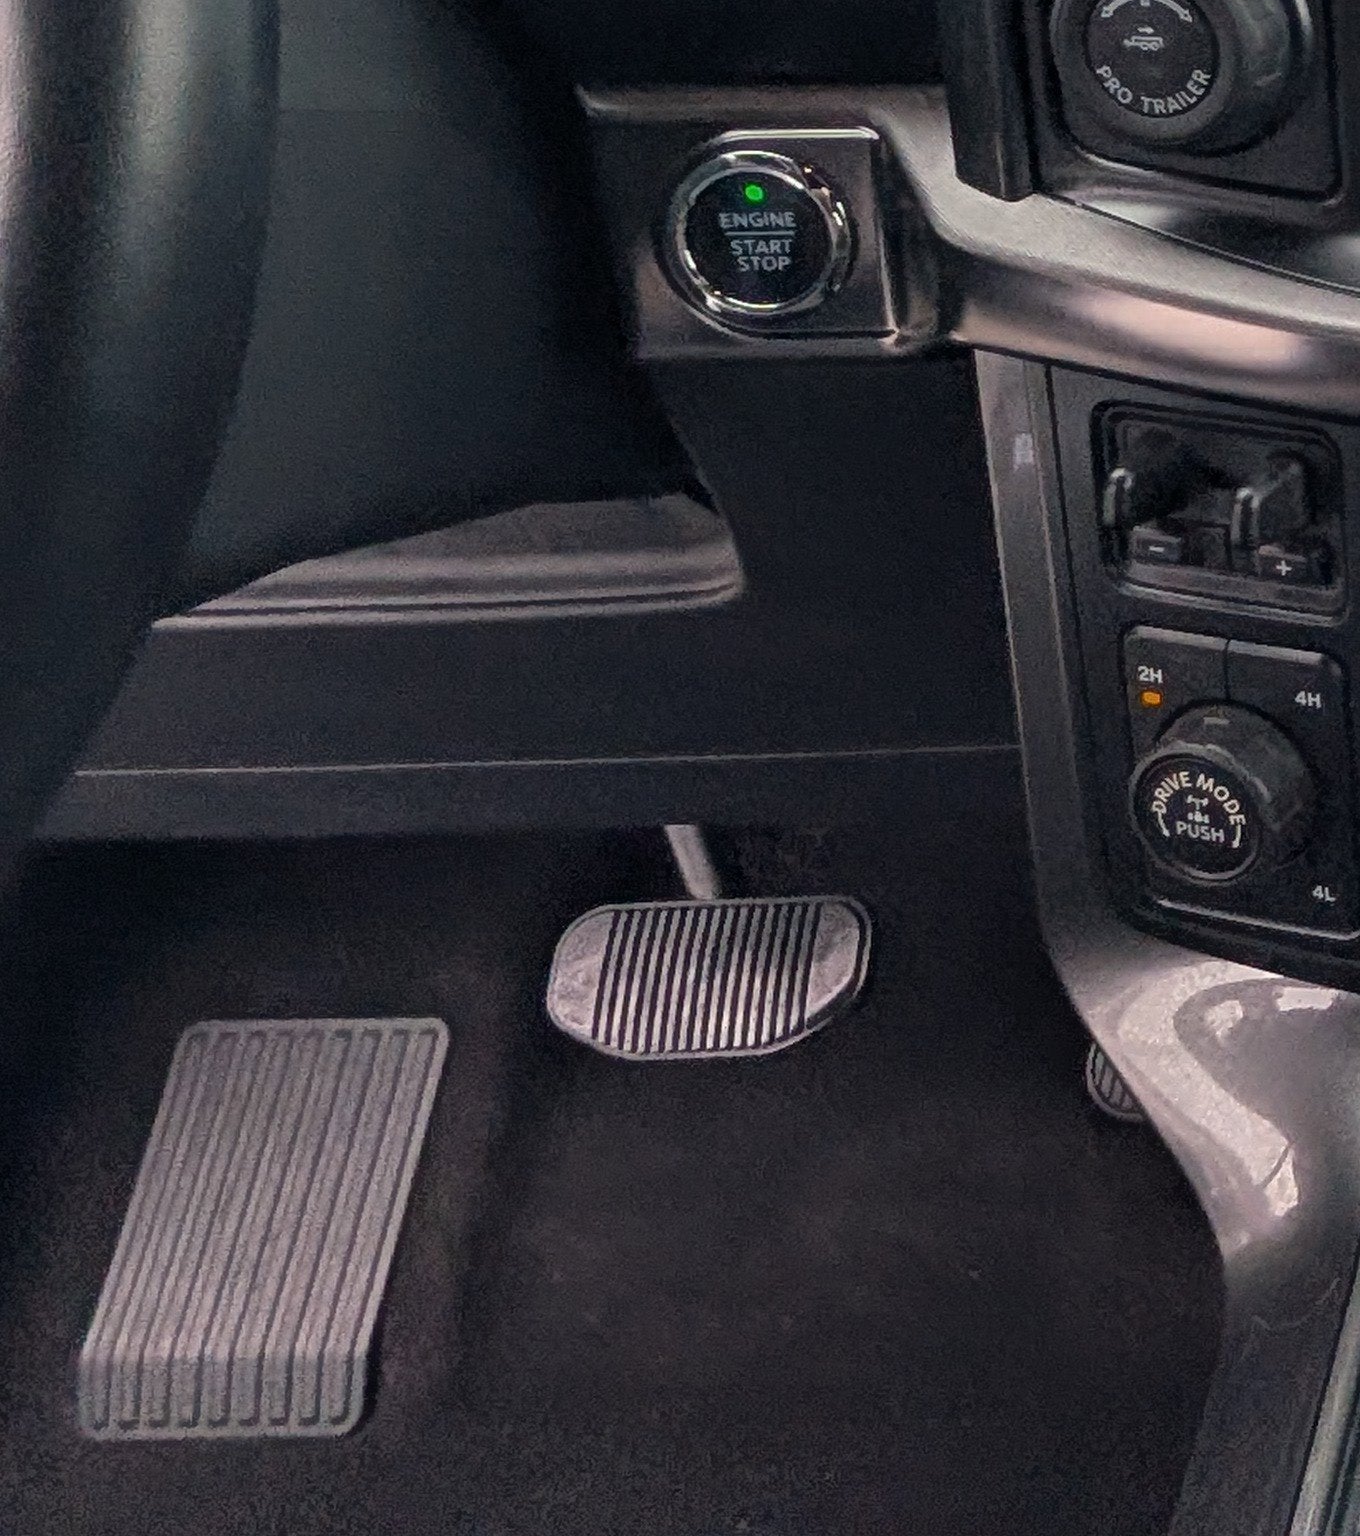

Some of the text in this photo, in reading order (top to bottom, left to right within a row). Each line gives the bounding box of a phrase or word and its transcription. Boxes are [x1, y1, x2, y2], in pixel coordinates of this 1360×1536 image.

[1096, 65, 1212, 114] PRO TRAILER
[719, 211, 797, 229] ENGINE
[730, 239, 793, 257] START
[736, 256, 792, 273] STOP
[1137, 665, 1164, 685] 2H
[1294, 690, 1322, 709] 4H
[1151, 771, 1247, 826] DRIVE MODE
[1176, 820, 1225, 843] PUSH
[1312, 884, 1337, 903] 4L
